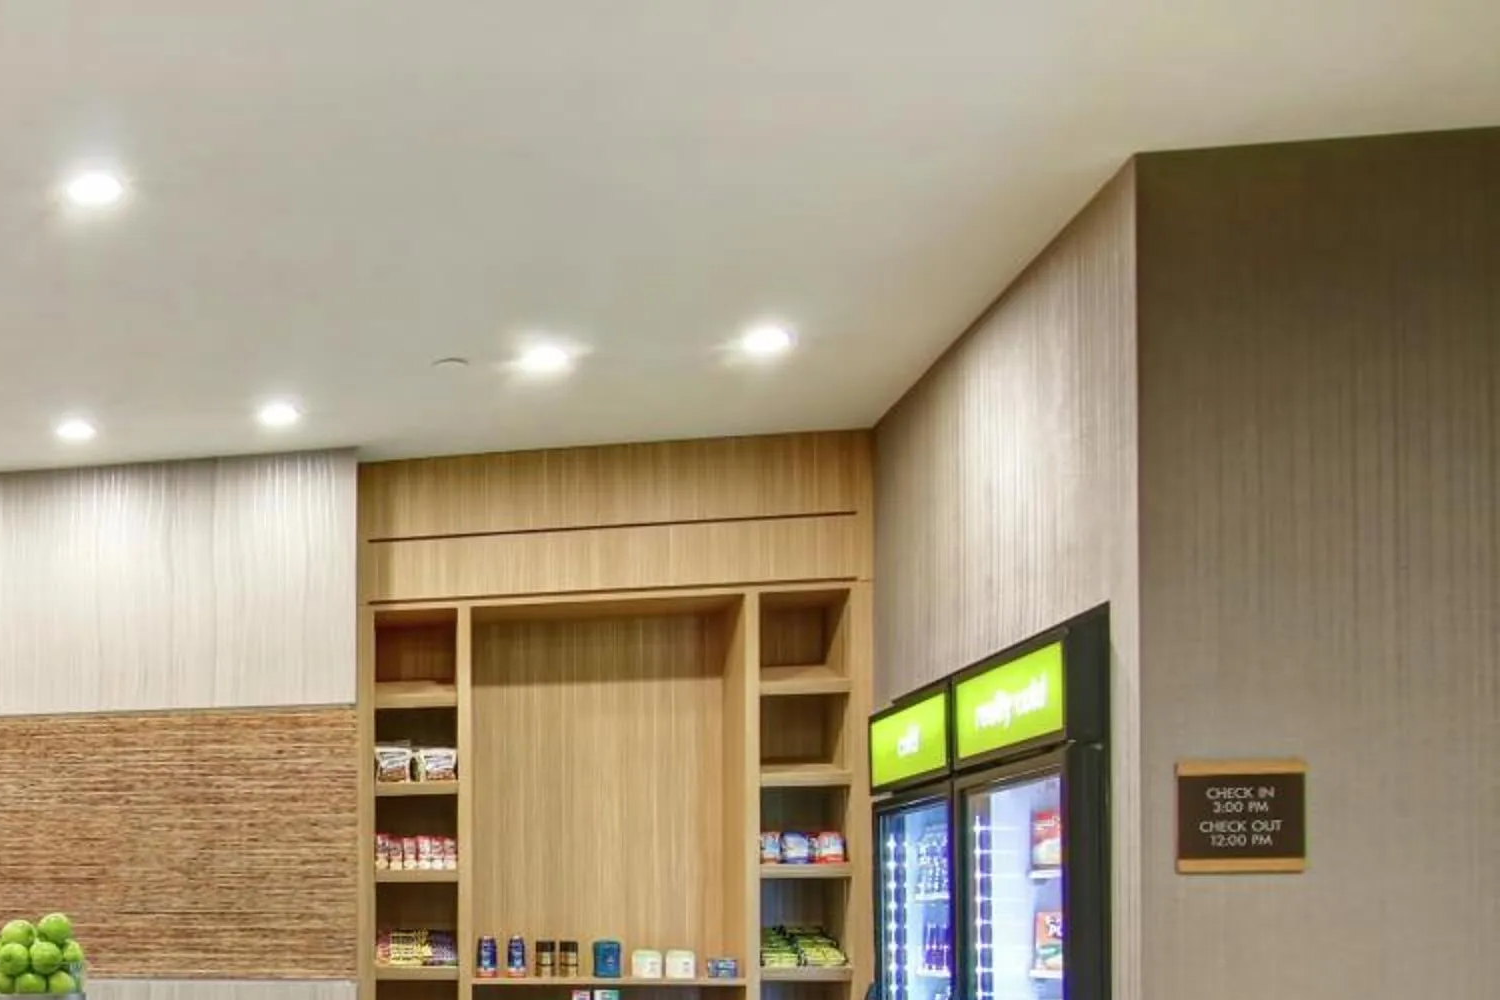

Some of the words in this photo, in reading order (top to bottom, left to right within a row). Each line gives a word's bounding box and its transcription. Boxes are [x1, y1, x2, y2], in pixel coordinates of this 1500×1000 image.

[1206, 787, 1253, 800] CHECK
[1258, 786, 1276, 799] IN
[1212, 801, 1244, 813] 3:00
[1248, 801, 1269, 812] PM
[1199, 820, 1247, 833] CHECK
[1251, 819, 1283, 832] OUT
[1210, 834, 1247, 847] 12:00
[1251, 834, 1273, 846] PM
